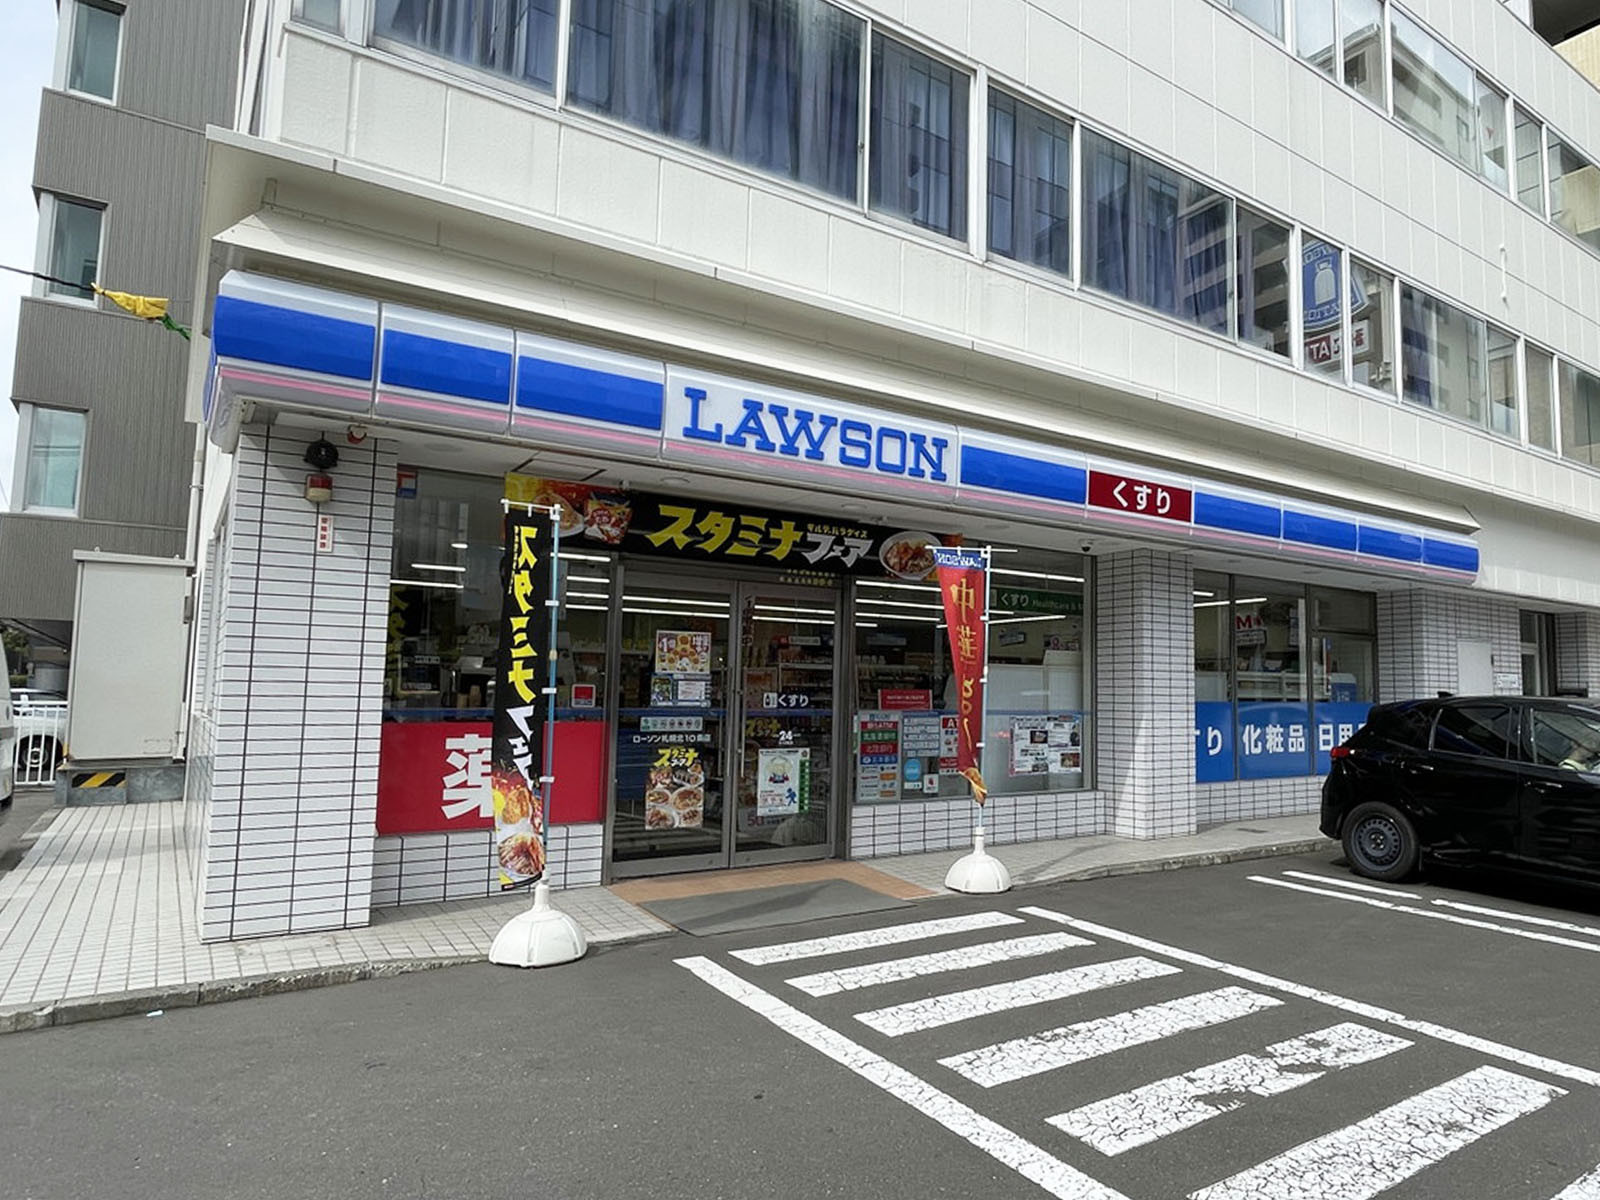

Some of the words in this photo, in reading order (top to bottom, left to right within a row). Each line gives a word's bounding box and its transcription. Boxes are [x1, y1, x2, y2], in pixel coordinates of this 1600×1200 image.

[682, 387, 948, 482] LAWSON
[1112, 480, 1171, 515] くすり
[1000, 593, 1029, 607] くすり
[778, 694, 809, 708] くすり
[1242, 724, 1306, 756] 化粧品
[1318, 722, 1367, 751] 日用
